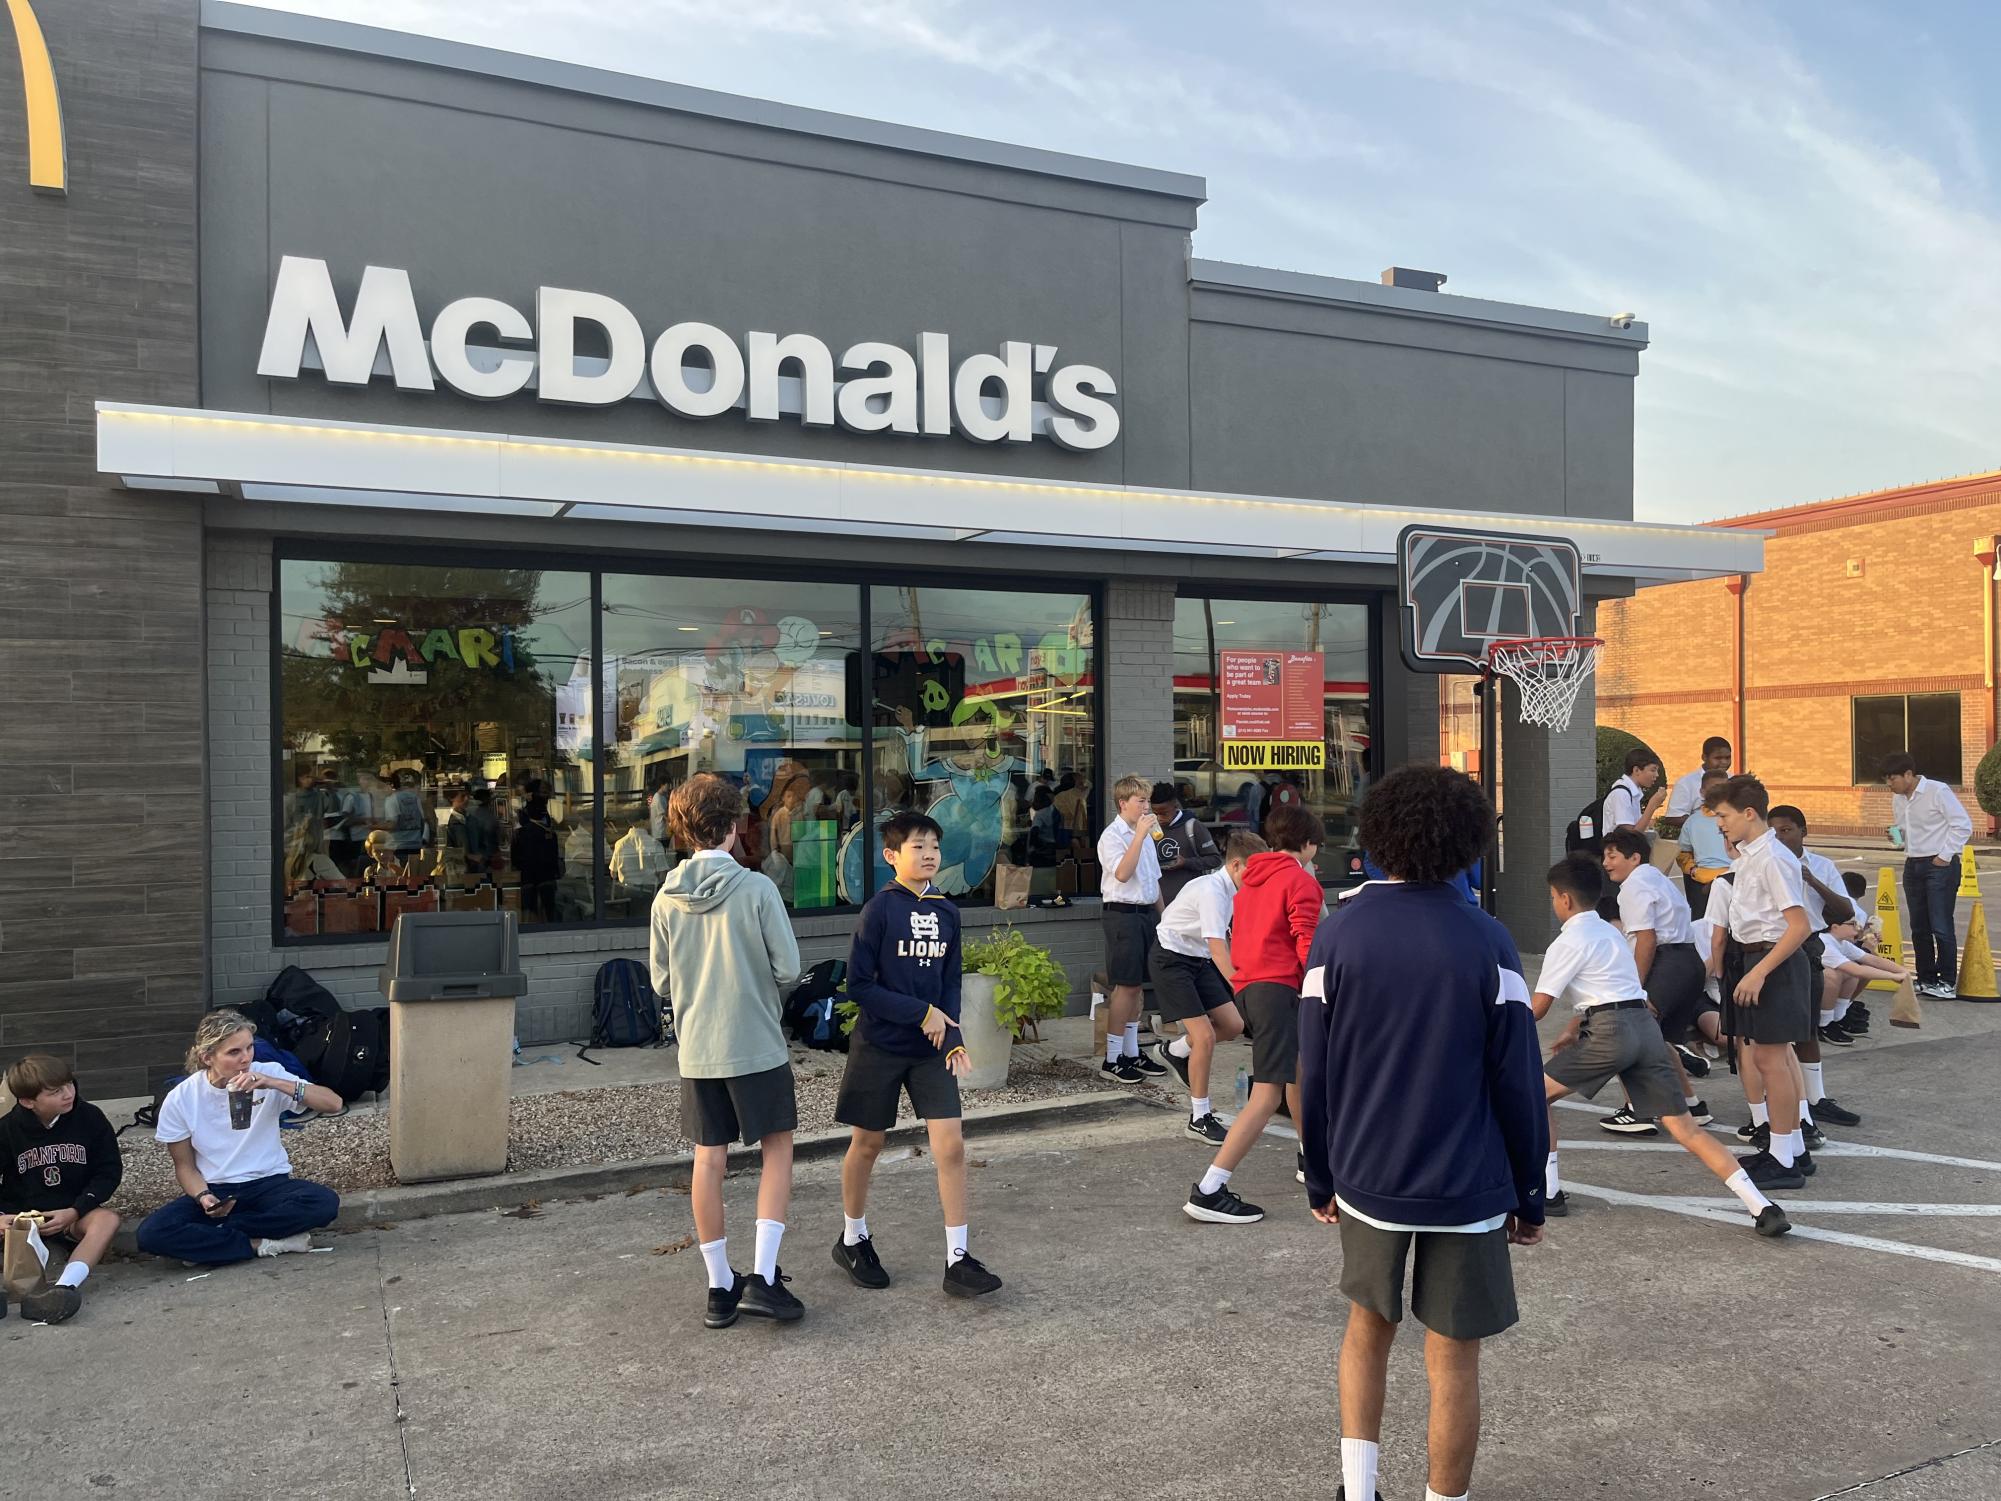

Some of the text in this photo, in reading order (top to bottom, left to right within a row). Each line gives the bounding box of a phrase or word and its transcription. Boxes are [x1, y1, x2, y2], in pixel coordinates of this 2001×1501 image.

[257, 255, 1121, 452] McDonald's
[621, 657, 648, 665] Bacon
[1237, 657, 1257, 665] people
[1228, 745, 1321, 765] NOW HIRING
[897, 940, 948, 958] LIONS
[1877, 944, 1893, 955] WET
[17, 1143, 87, 1175] STANFORD
